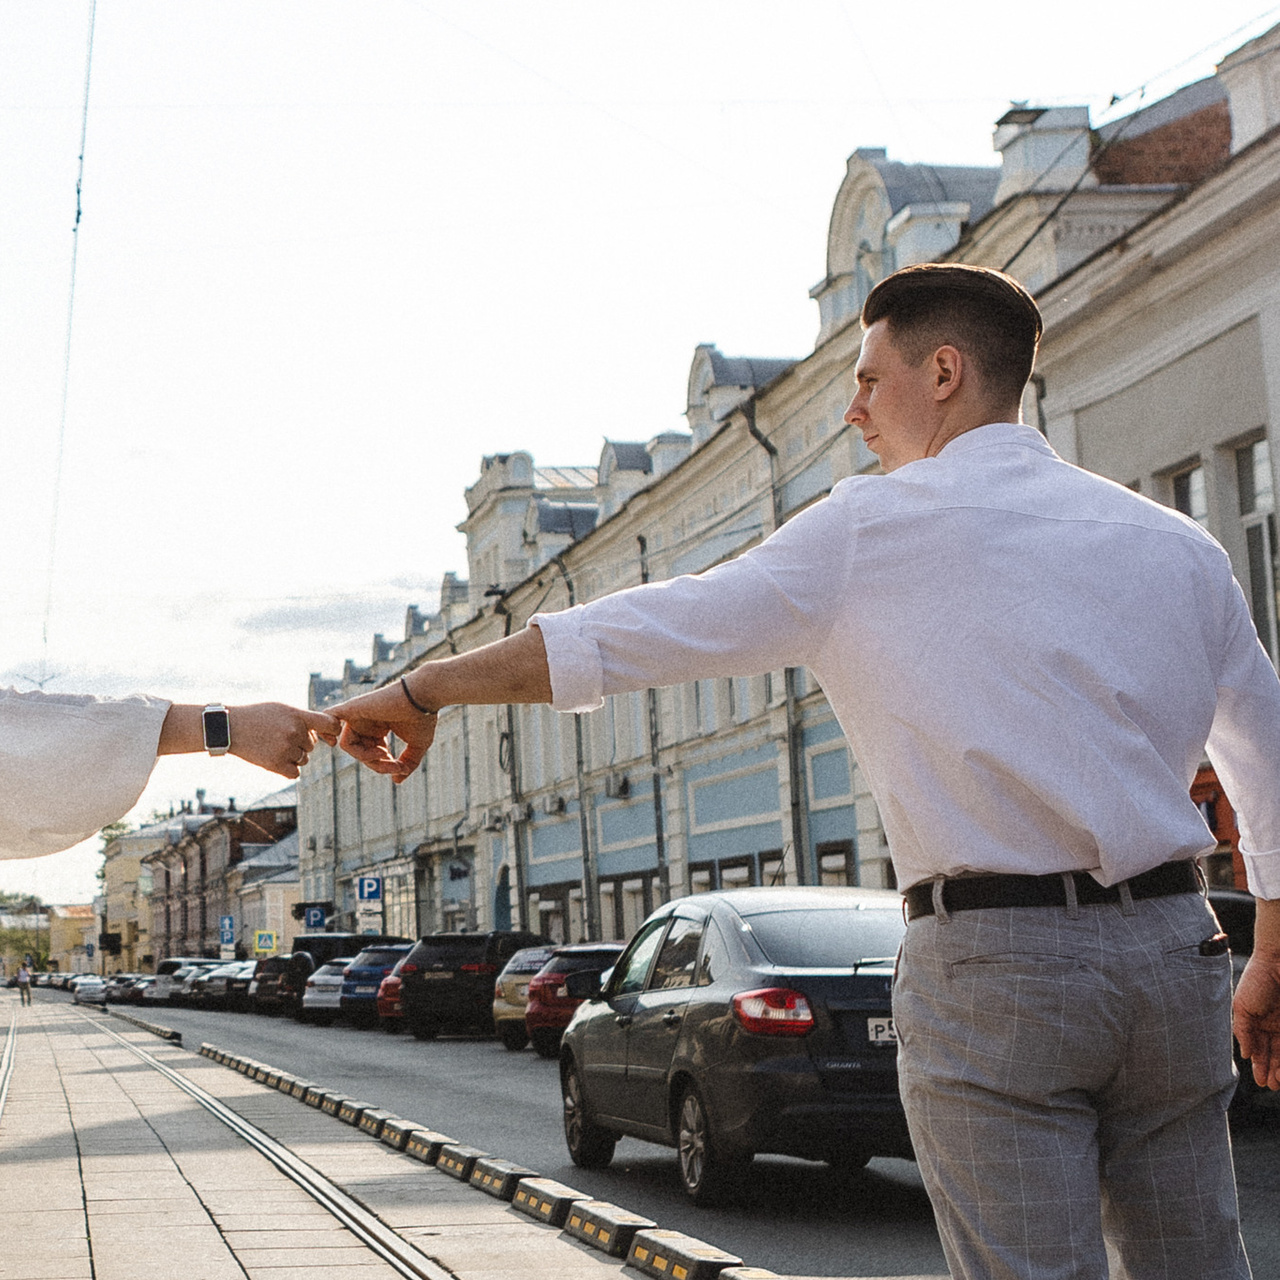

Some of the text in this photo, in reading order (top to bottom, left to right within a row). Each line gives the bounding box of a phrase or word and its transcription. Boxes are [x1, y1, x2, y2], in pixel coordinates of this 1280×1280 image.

[363, 879, 377, 898] P
[310, 910, 321, 926] P
[223, 931, 232, 943] P
